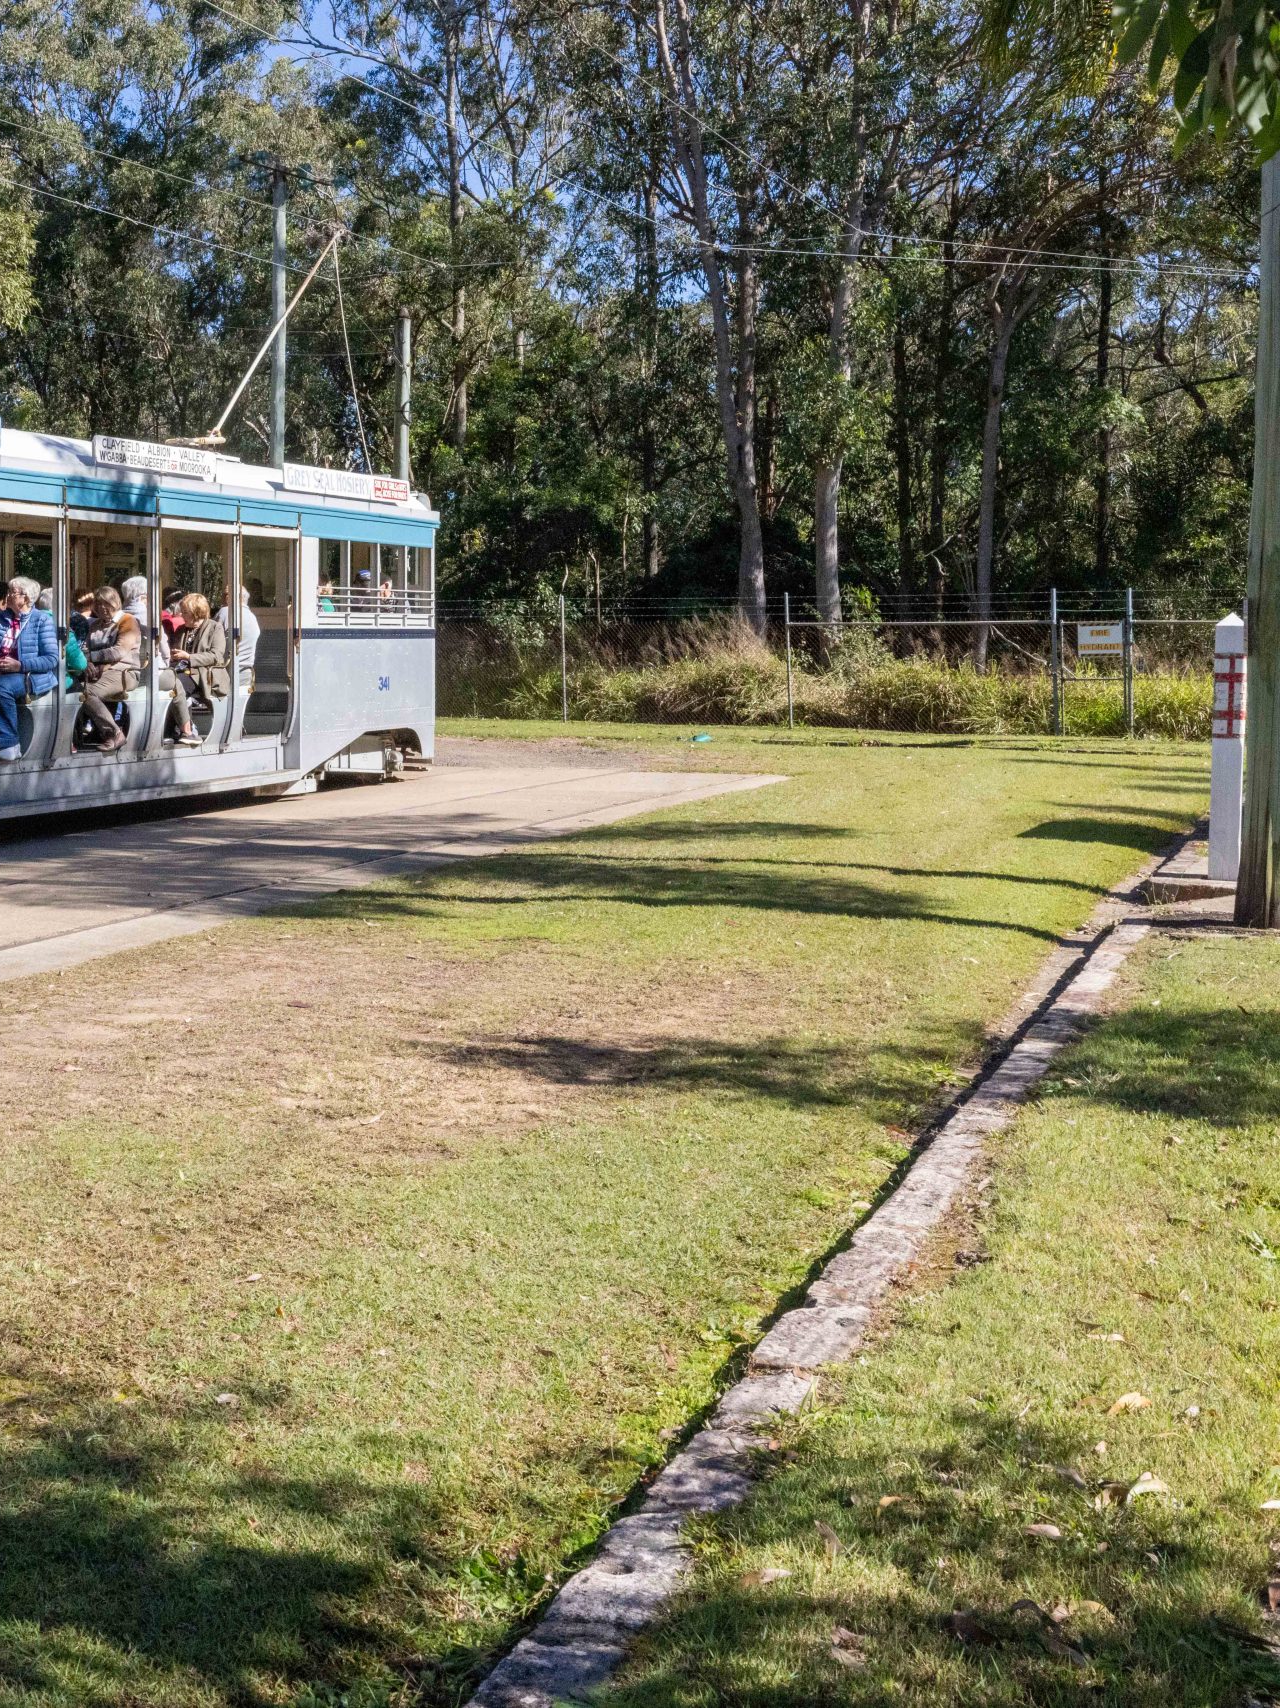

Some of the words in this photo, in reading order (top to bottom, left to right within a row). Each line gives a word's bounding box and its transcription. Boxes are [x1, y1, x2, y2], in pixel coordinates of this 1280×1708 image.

[102, 438, 140, 453] CLAYFIELD
[147, 446, 171, 457] ALBION
[179, 449, 206, 462] VALLEY
[313, 470, 335, 491] SEAL
[336, 473, 369, 495] HOSIERY
[379, 676, 389, 691] 341
